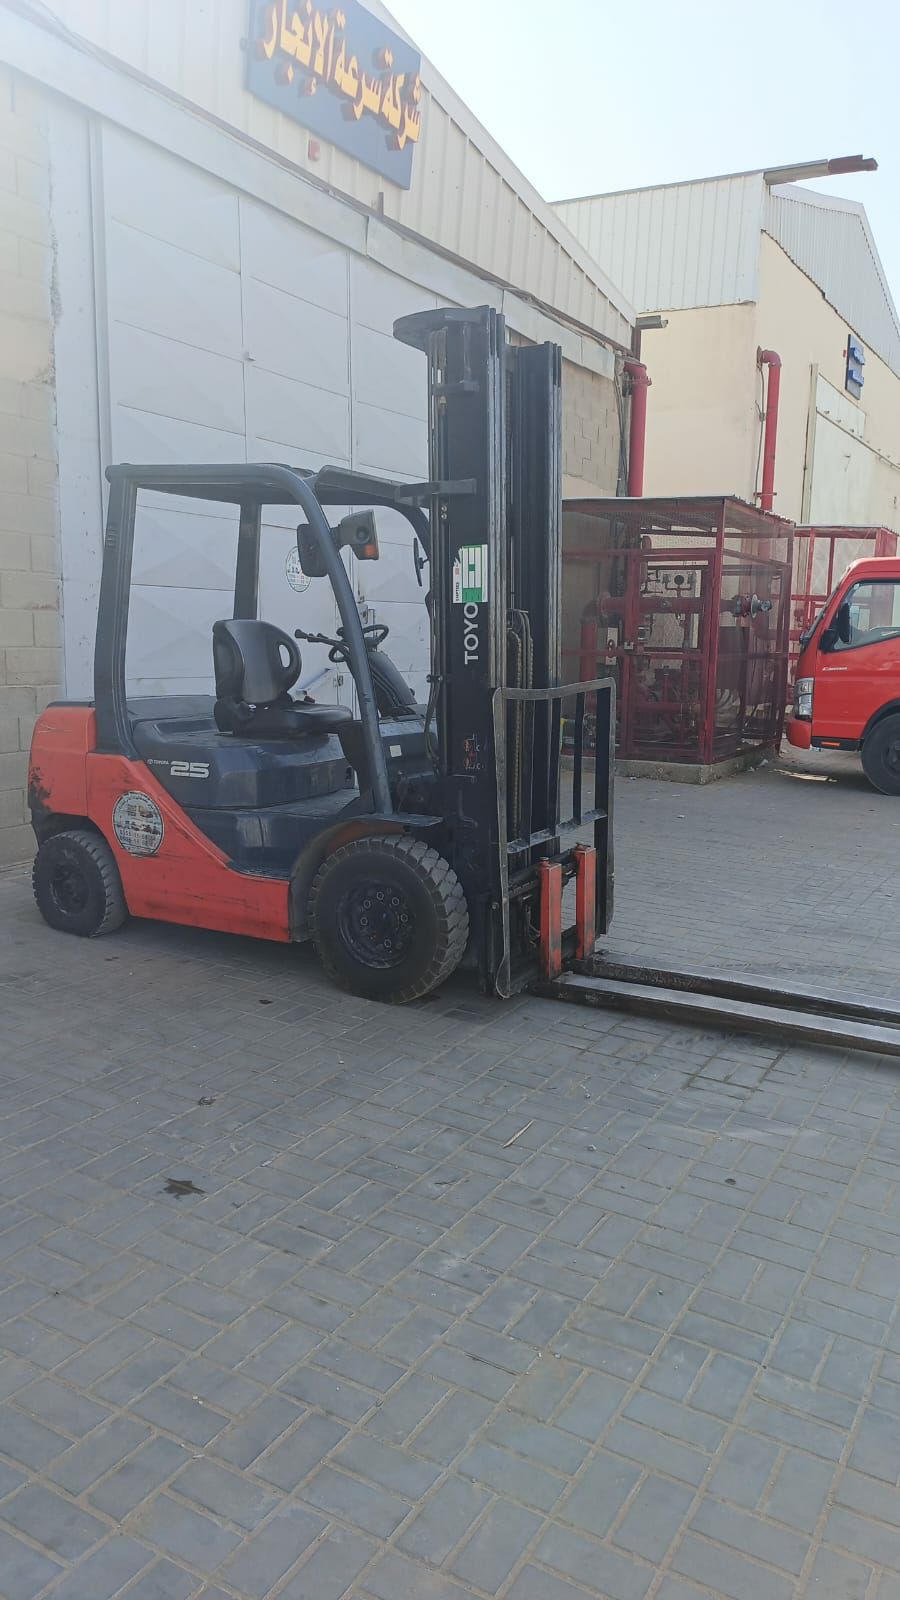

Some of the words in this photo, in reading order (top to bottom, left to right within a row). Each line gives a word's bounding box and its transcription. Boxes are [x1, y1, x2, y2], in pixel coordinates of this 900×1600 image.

[334, 10, 381, 120] سرعة
[382, 48, 422, 150] شركة
[463, 602, 479, 665] TOYO
[170, 760, 210, 778] 25
